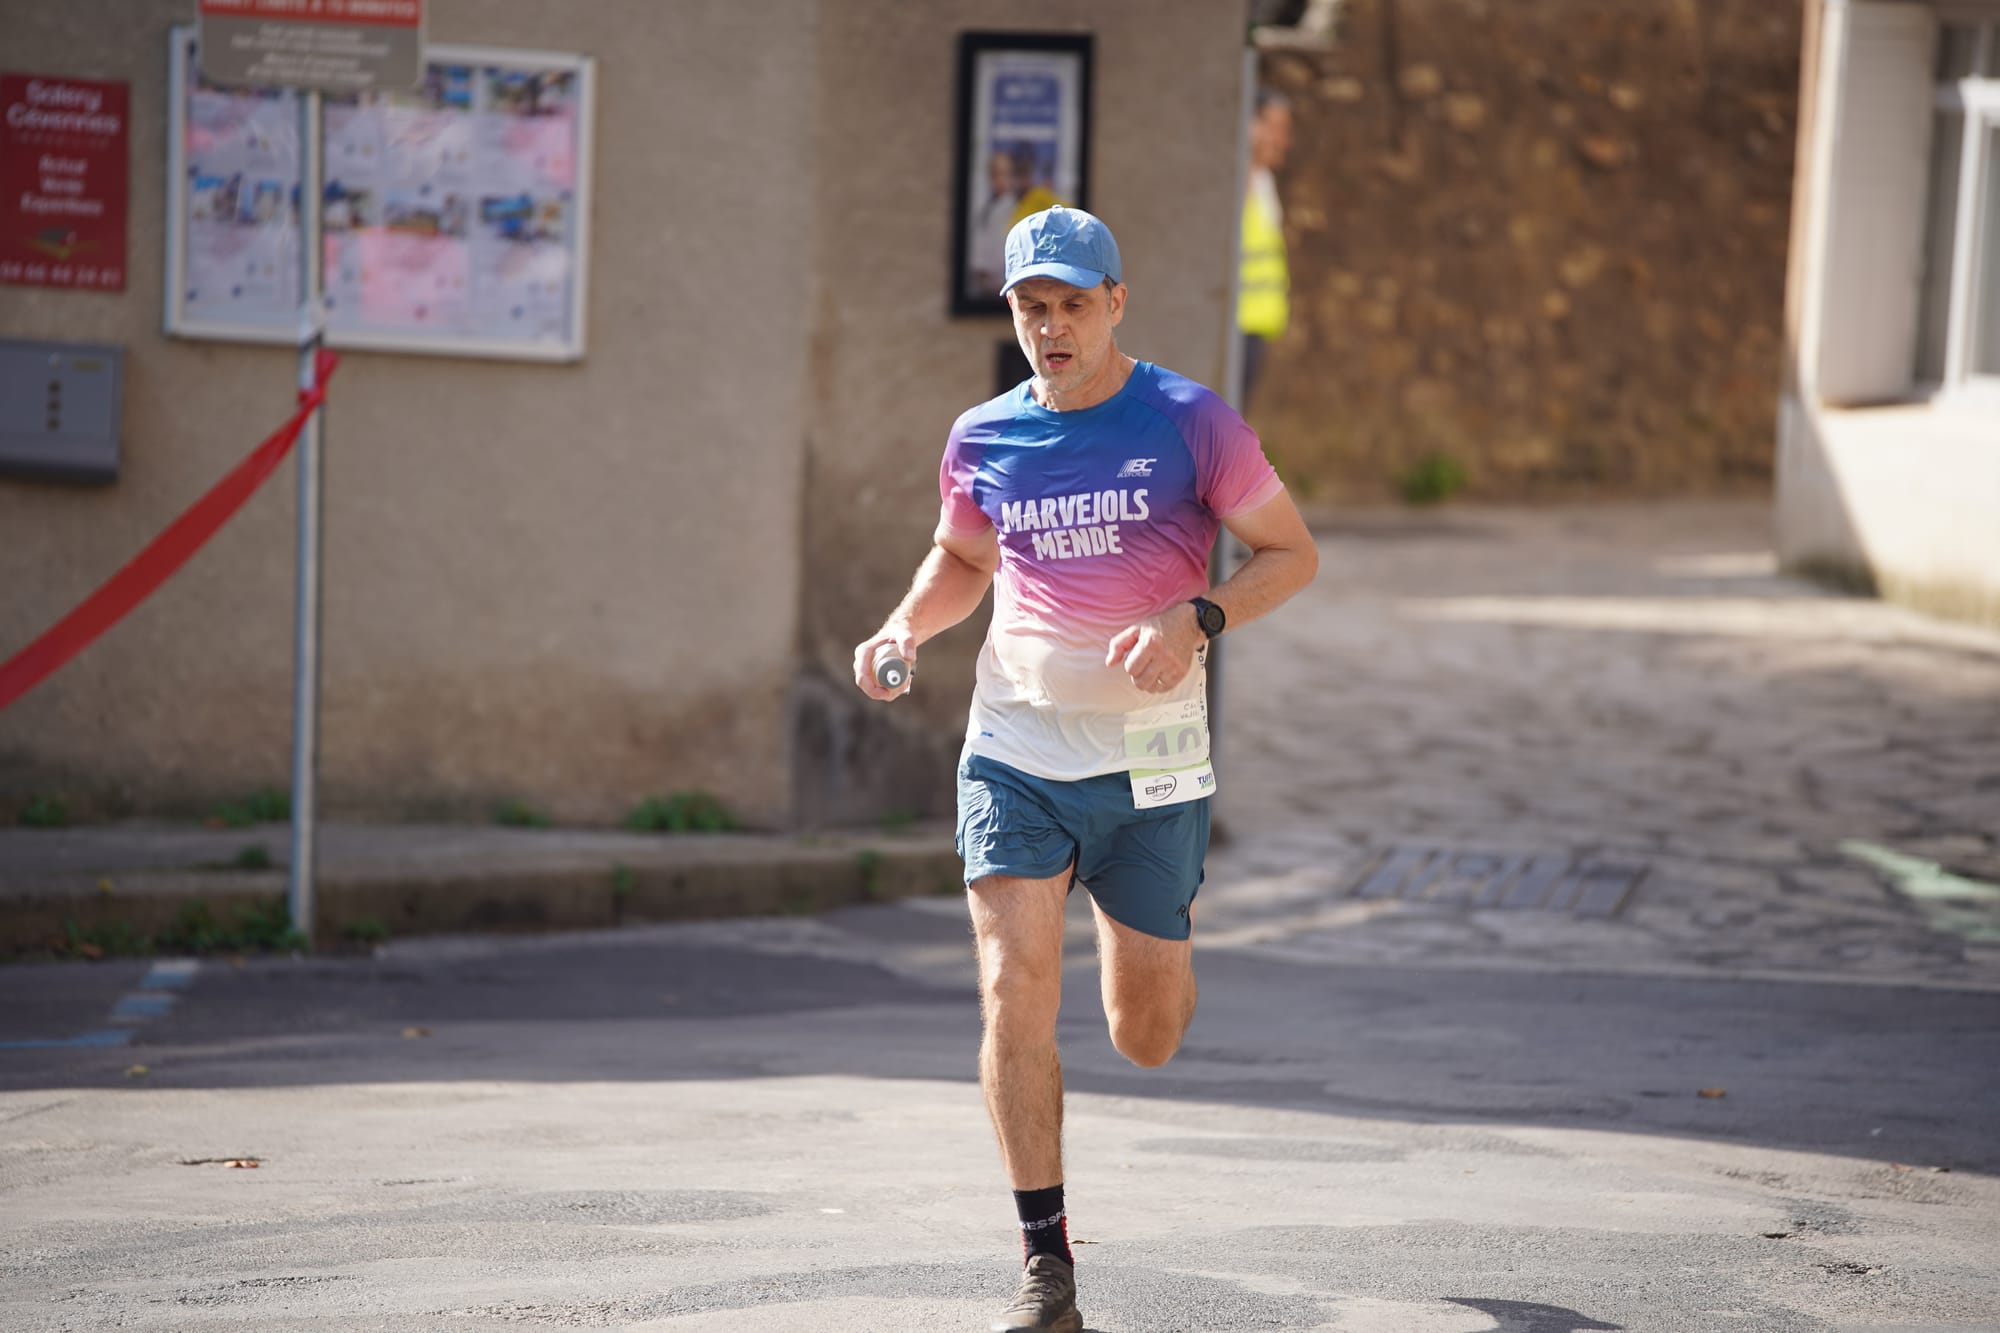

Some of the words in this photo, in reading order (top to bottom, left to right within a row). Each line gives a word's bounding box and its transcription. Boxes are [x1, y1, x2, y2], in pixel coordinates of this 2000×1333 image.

[1001, 488, 1150, 534] MARVEJOLS
[1031, 524, 1124, 561] MENDE
[1145, 783, 1173, 795] BFP
